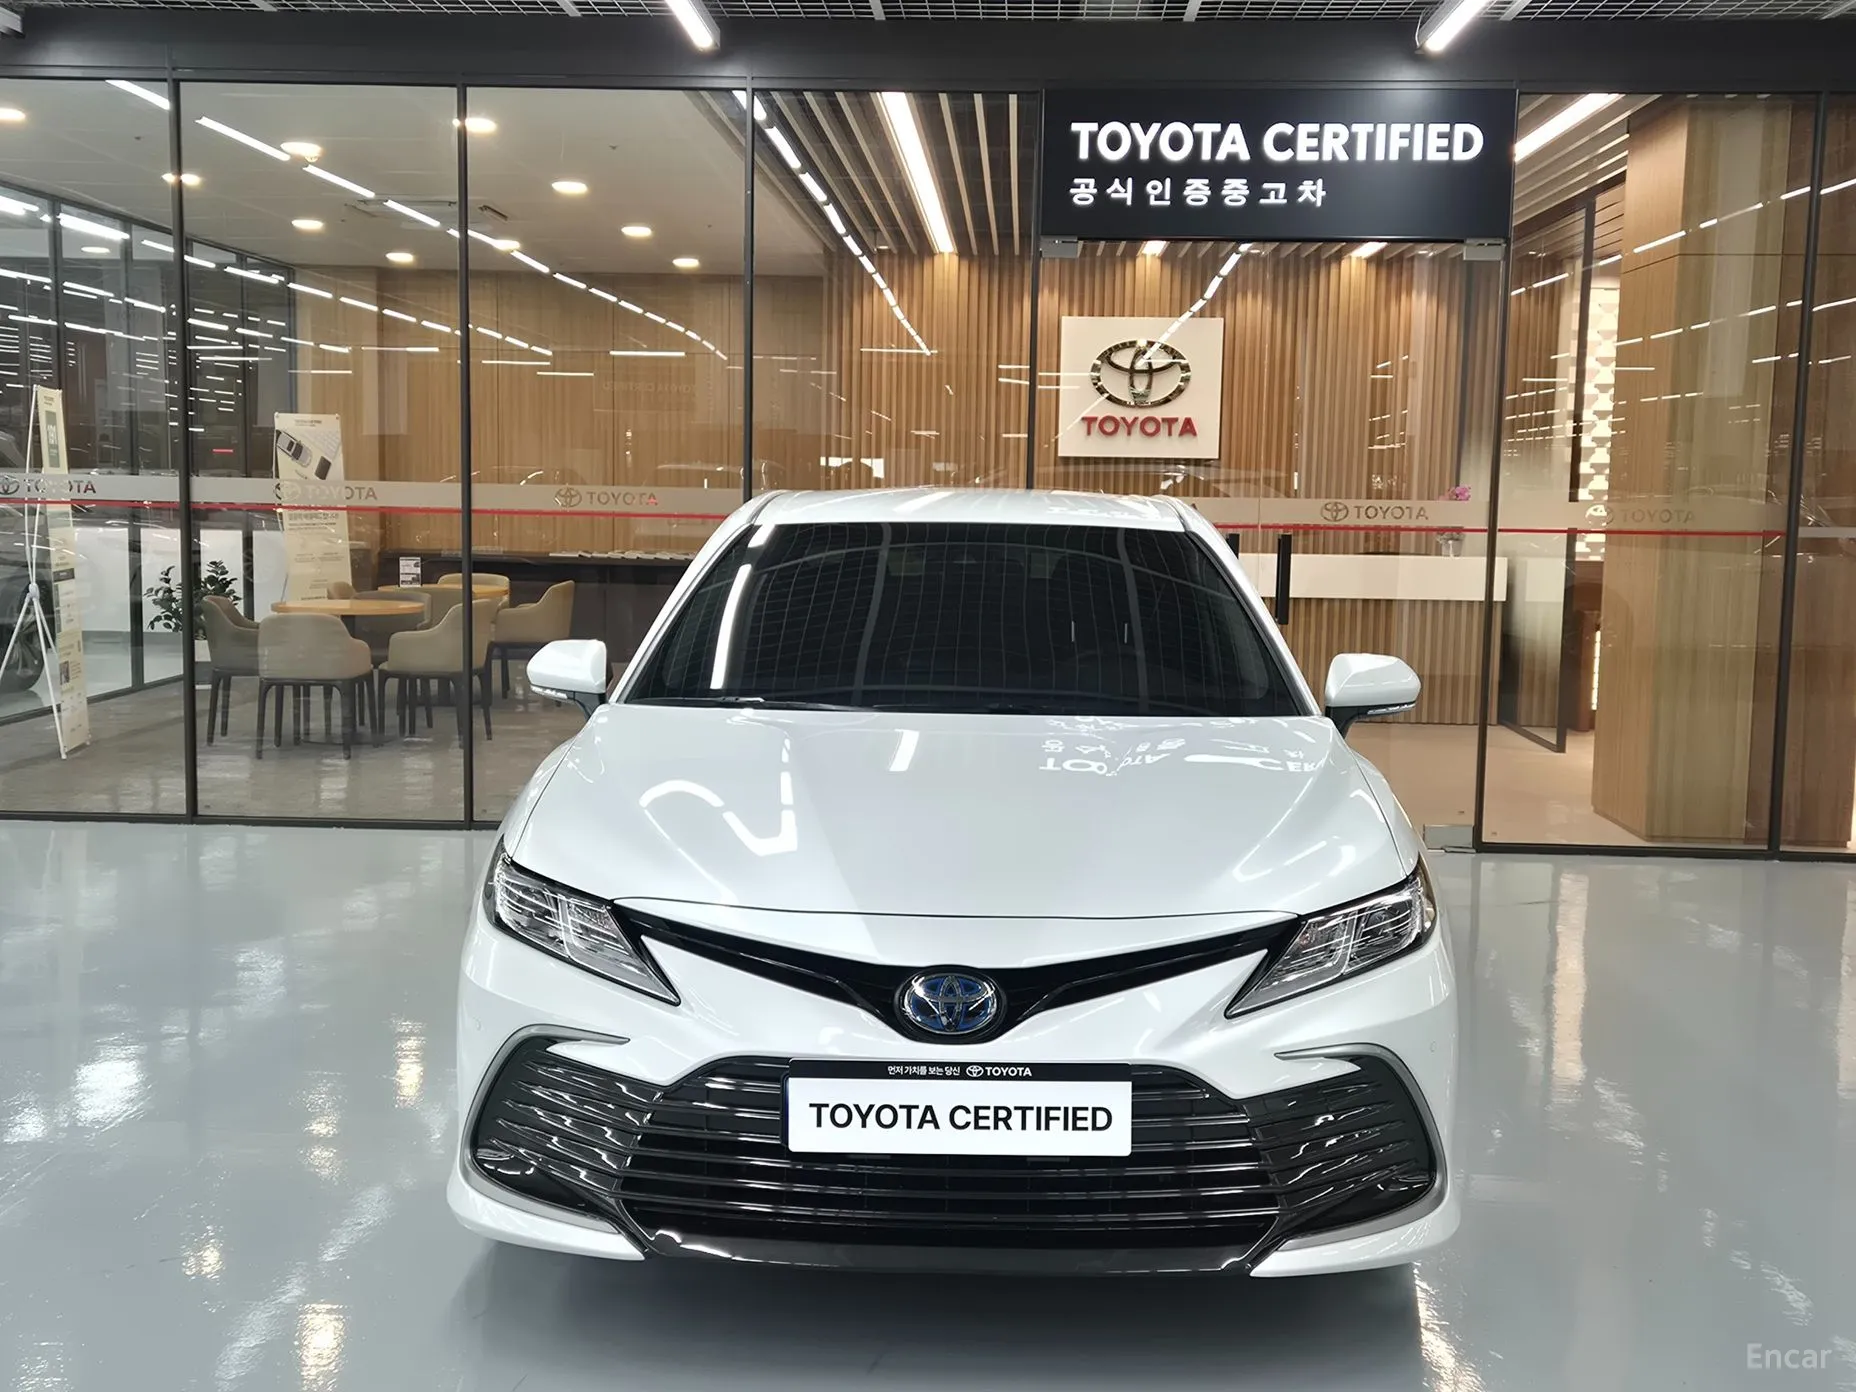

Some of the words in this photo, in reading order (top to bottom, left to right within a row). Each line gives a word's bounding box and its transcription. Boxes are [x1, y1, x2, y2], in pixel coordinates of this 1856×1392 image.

[1071, 121, 1251, 161] TOYOTA
[1263, 122, 1485, 162] CERTIFIED
[1081, 415, 1198, 437] TOYOTA
[586, 491, 659, 506] TOYOTA
[1354, 505, 1429, 520] TOYOTA
[1620, 508, 1696, 524] TOYOTA
[887, 1065, 903, 1075] 먼저
[904, 1065, 927, 1076] 가치를
[928, 1066, 944, 1076] 보는
[944, 1066, 960, 1076] 당신
[985, 1067, 1032, 1077] TOYOTA
[809, 1103, 940, 1129] TOYOTA
[949, 1105, 1113, 1132] CERTIFIED
